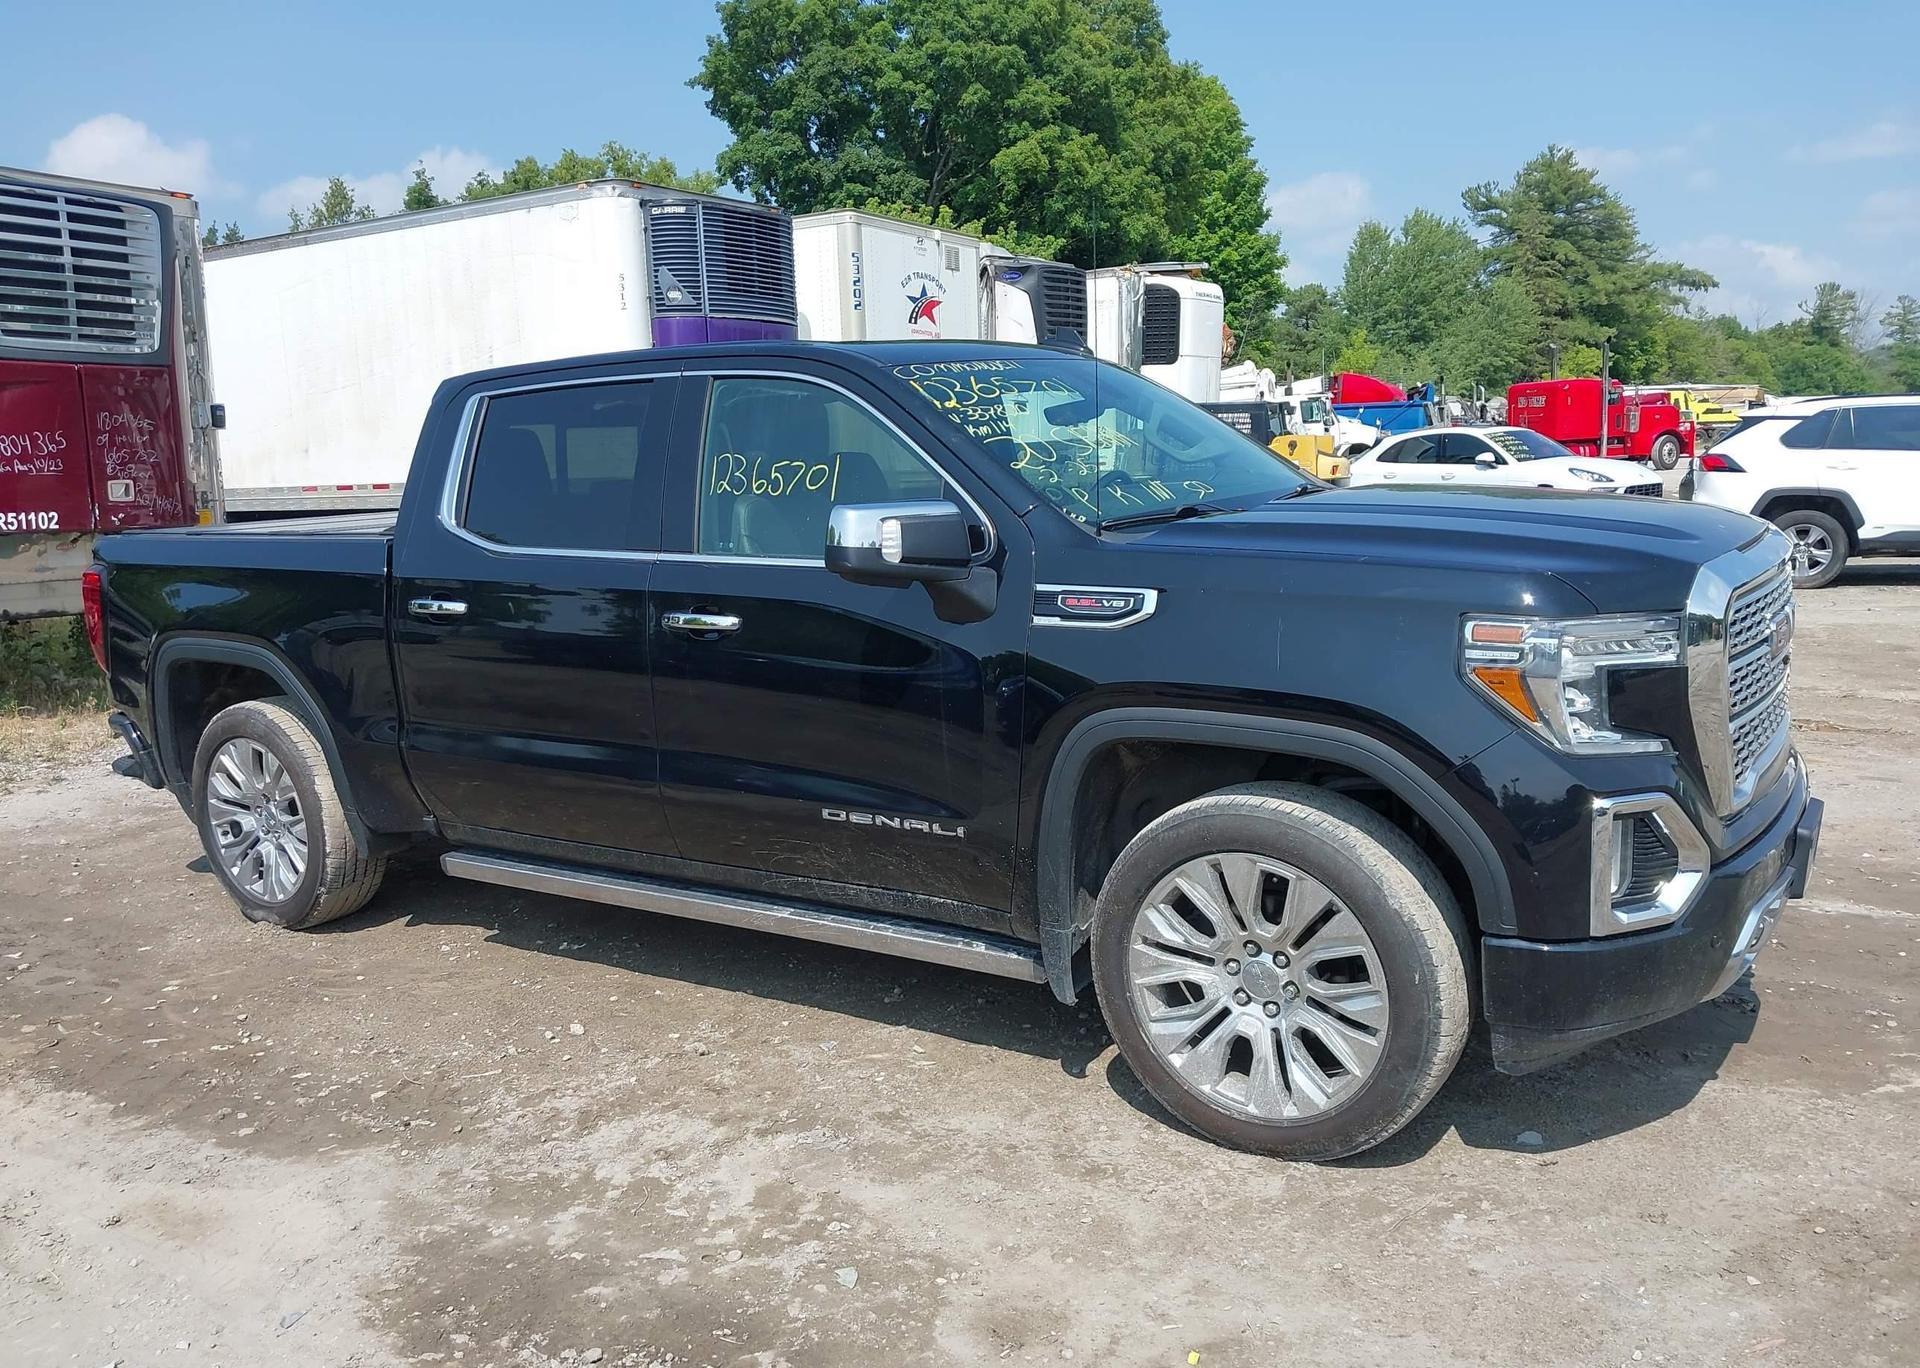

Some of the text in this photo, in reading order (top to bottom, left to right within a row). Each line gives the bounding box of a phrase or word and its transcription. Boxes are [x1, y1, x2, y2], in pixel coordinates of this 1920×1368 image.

[618, 273, 627, 311] 5312
[851, 252, 862, 311] 53202
[912, 271, 947, 296] TRANSPORT
[710, 453, 840, 502] 12365701
[821, 807, 968, 839] DENALI
